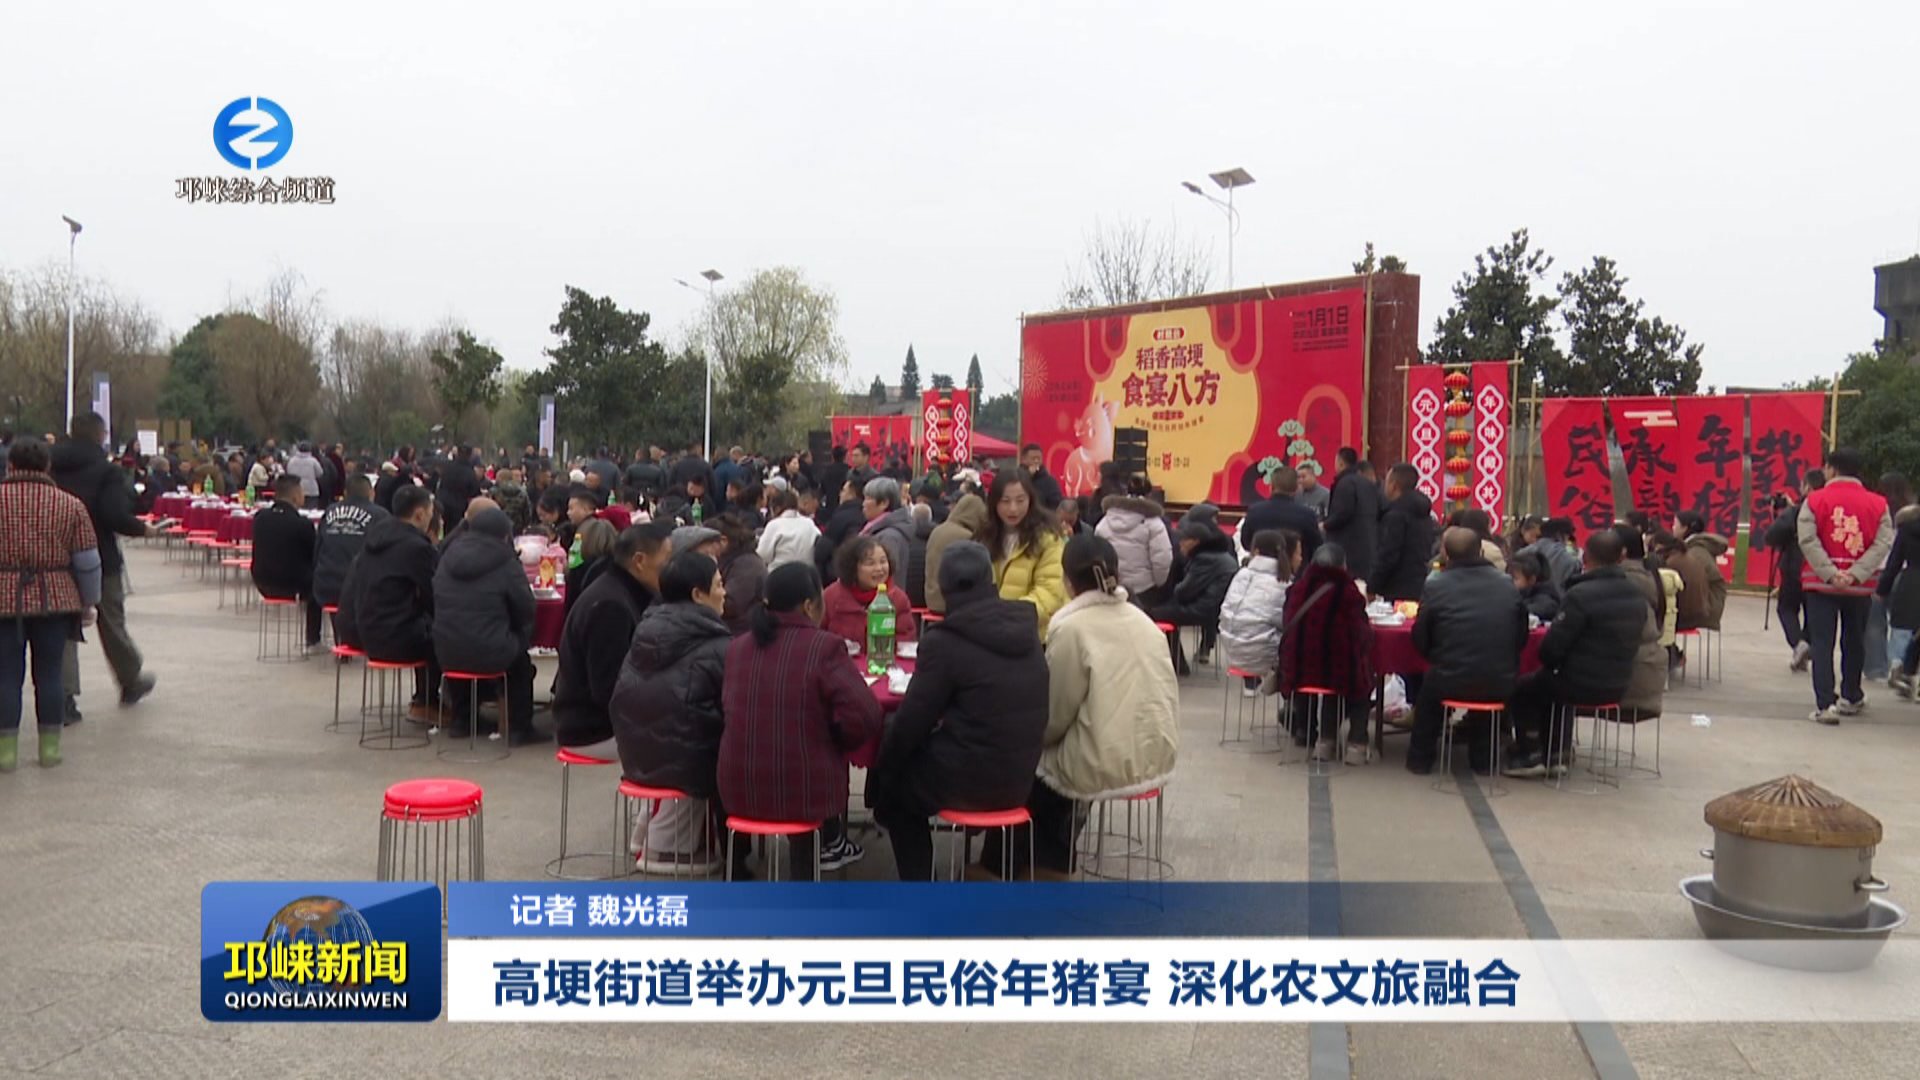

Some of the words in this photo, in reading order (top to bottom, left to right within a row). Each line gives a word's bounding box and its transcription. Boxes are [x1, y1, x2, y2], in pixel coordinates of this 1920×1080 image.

[1308, 305, 1348, 327] 1月1日
[1136, 344, 1203, 370] 稻香高埂
[1122, 370, 1220, 407] 食宴八方
[1559, 422, 1613, 530] 民俗
[1694, 414, 1744, 538] 年猪
